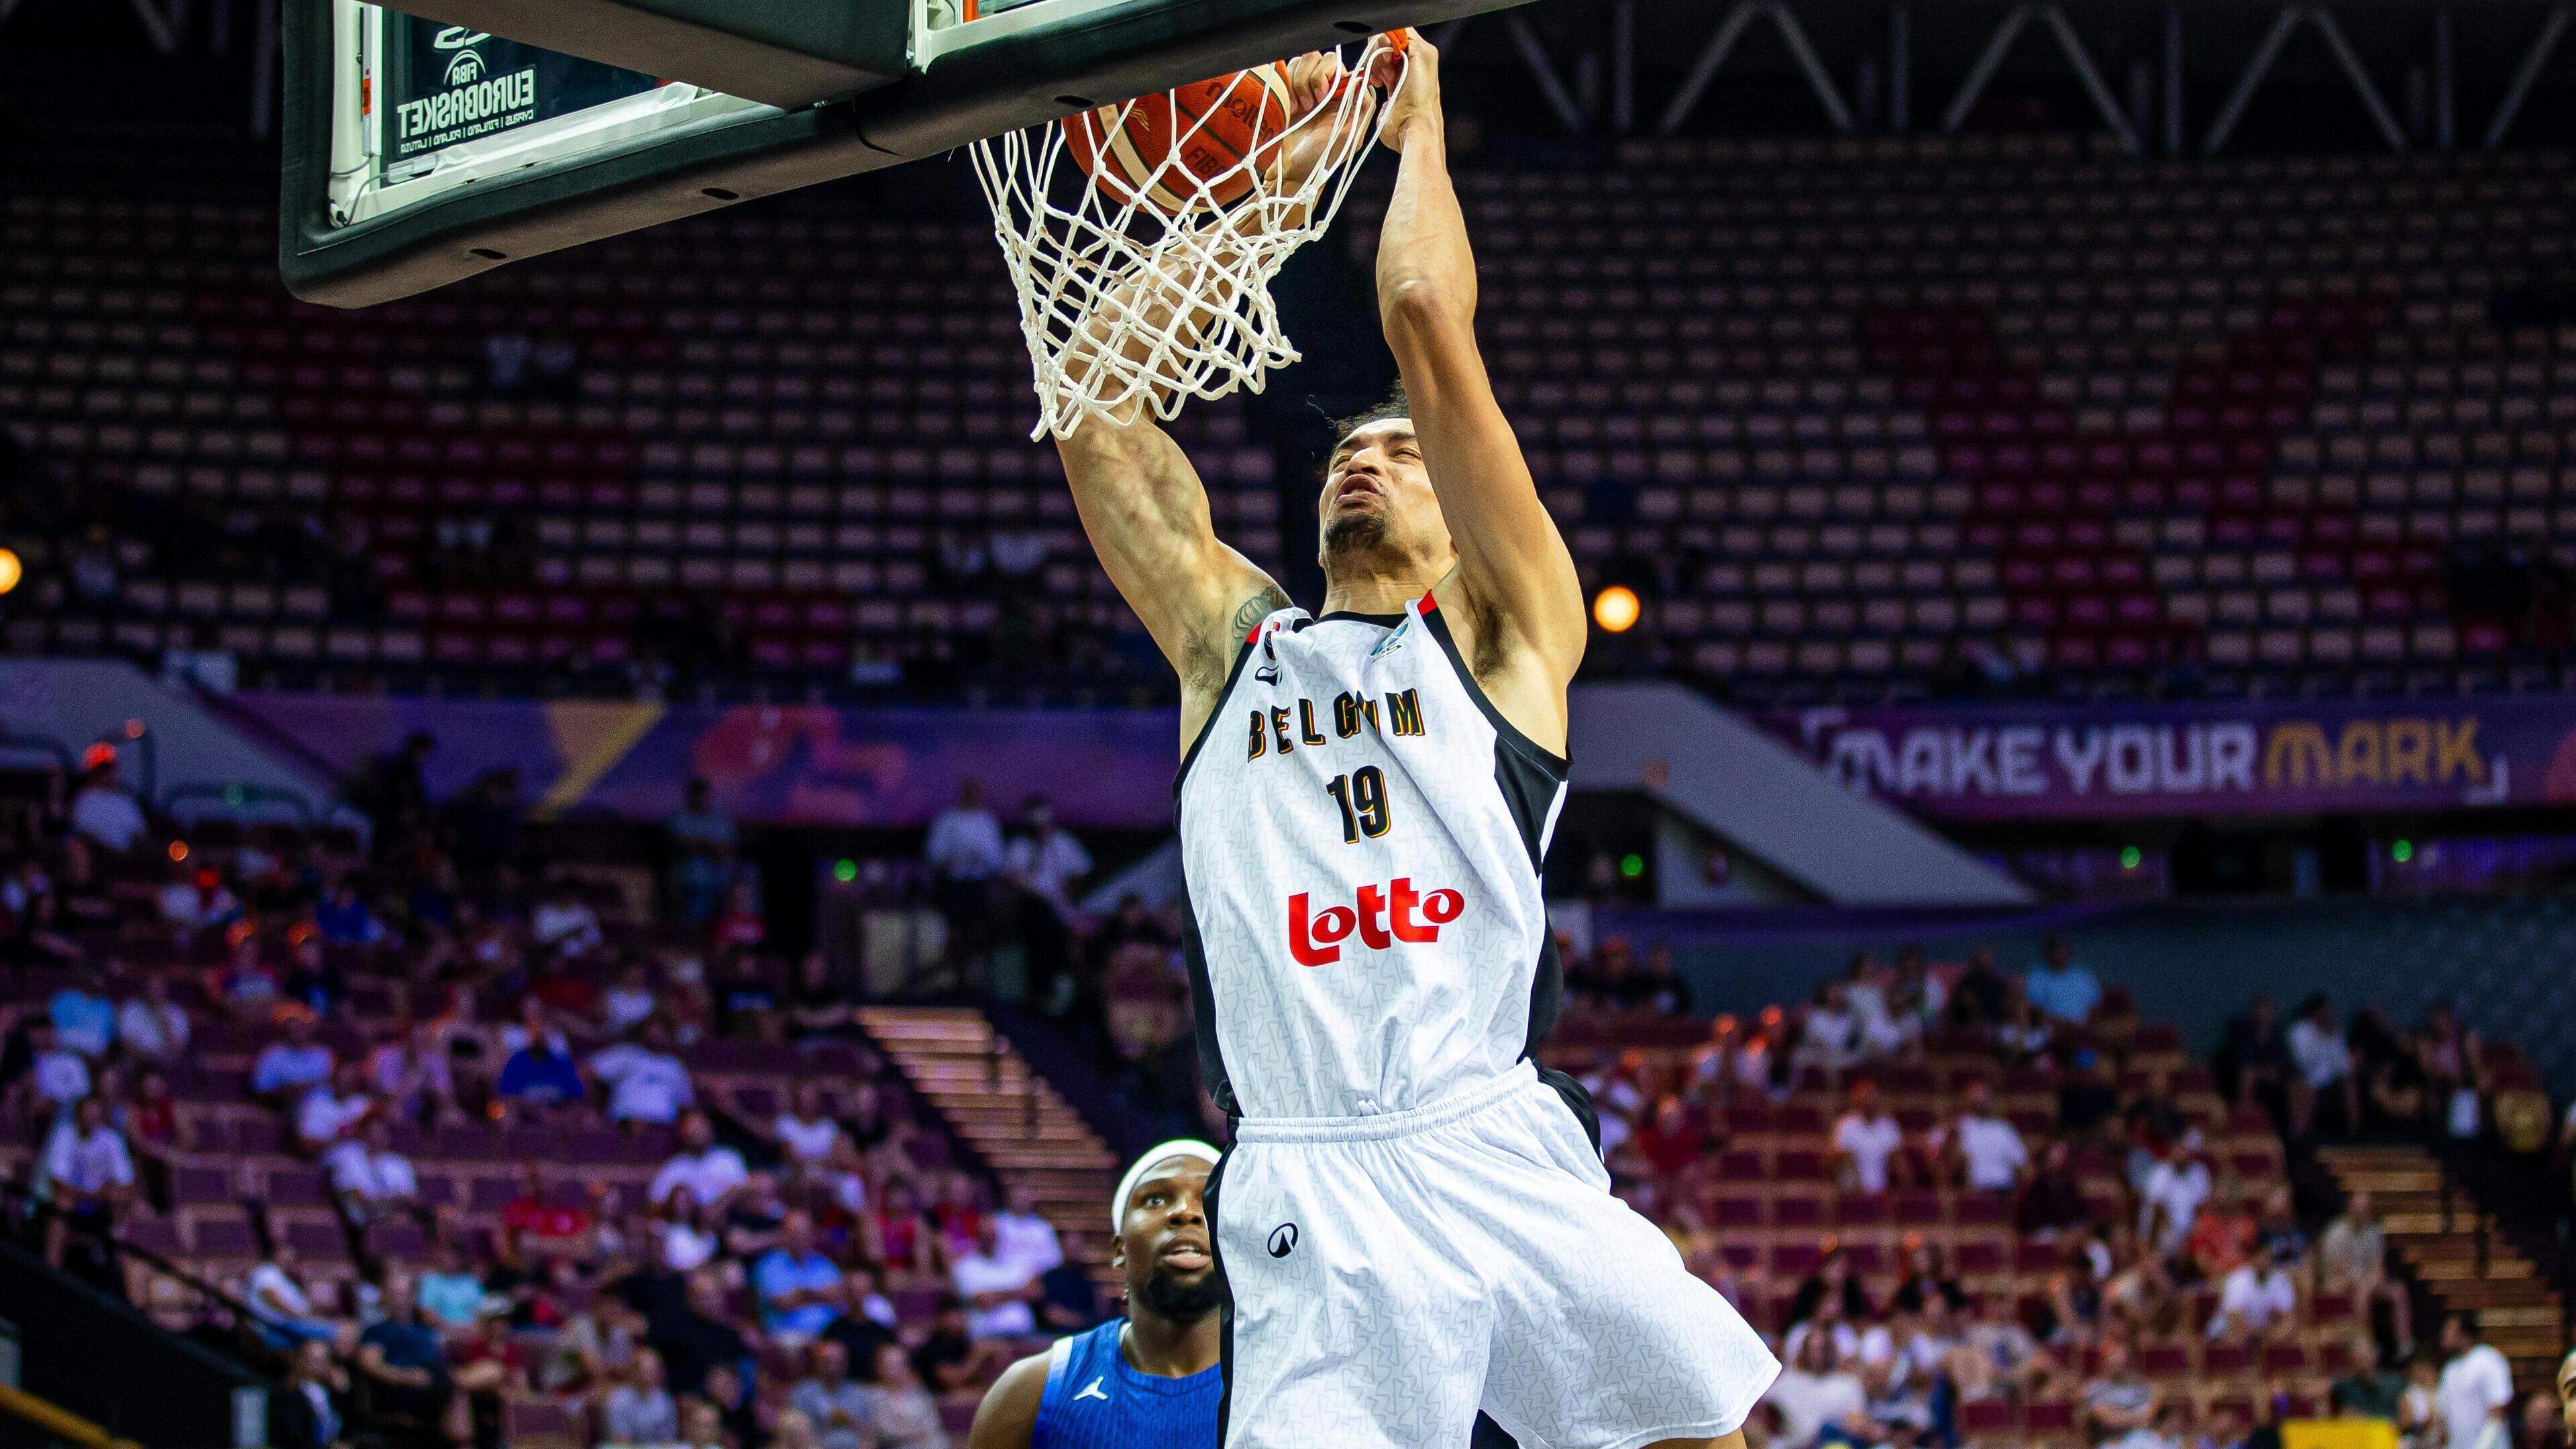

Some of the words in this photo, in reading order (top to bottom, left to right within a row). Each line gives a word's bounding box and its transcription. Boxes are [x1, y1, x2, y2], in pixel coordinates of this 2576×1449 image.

[1828, 728, 2049, 795] MAKE
[2053, 723, 2259, 793] YOUR
[2265, 715, 2481, 786] MARK
[1326, 765, 1391, 845] 19
[1288, 877, 1465, 967] Lotto
